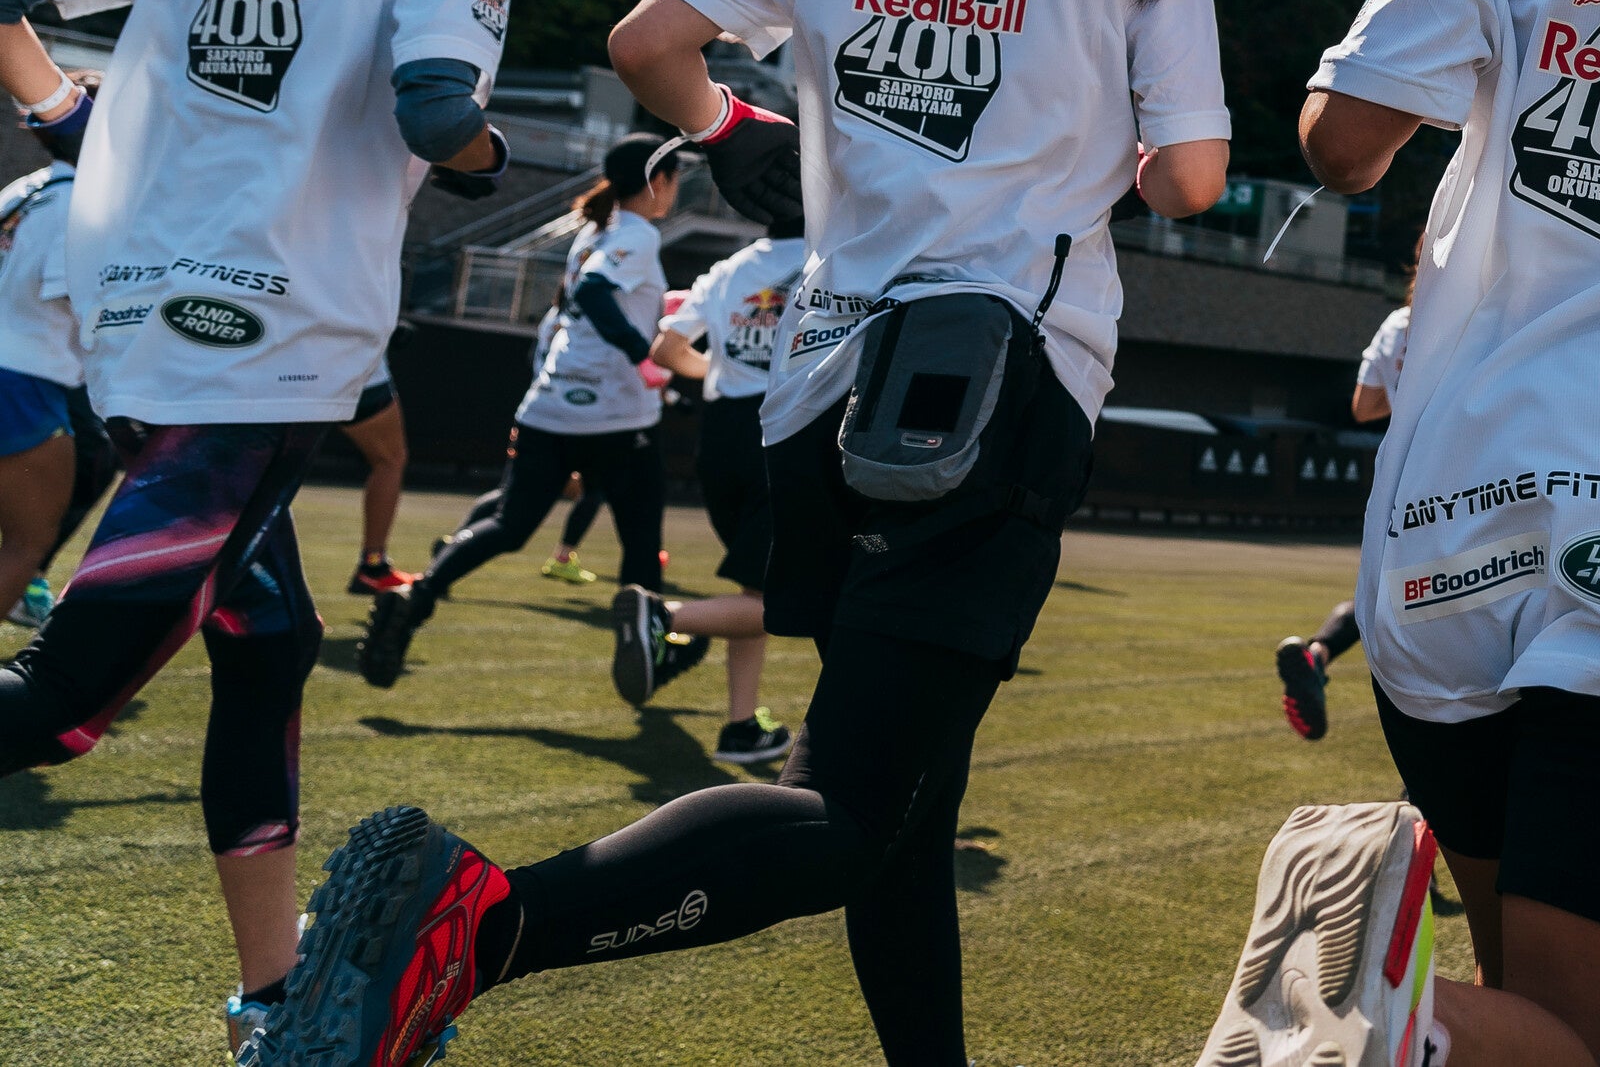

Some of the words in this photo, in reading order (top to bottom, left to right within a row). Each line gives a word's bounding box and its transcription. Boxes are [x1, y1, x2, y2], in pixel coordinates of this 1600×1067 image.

[206, 50, 265, 63] SAPPORO
[843, 17, 997, 86] 400
[199, 62, 272, 75] OKURAYAMA
[879, 79, 955, 102] SAPPORO
[865, 91, 962, 117] OKURAYAMA
[182, 301, 234, 324] LAND
[182, 318, 246, 342] ROVER
[1402, 471, 1538, 531] ANYTIME
[1404, 545, 1544, 601] BFGoodrich
